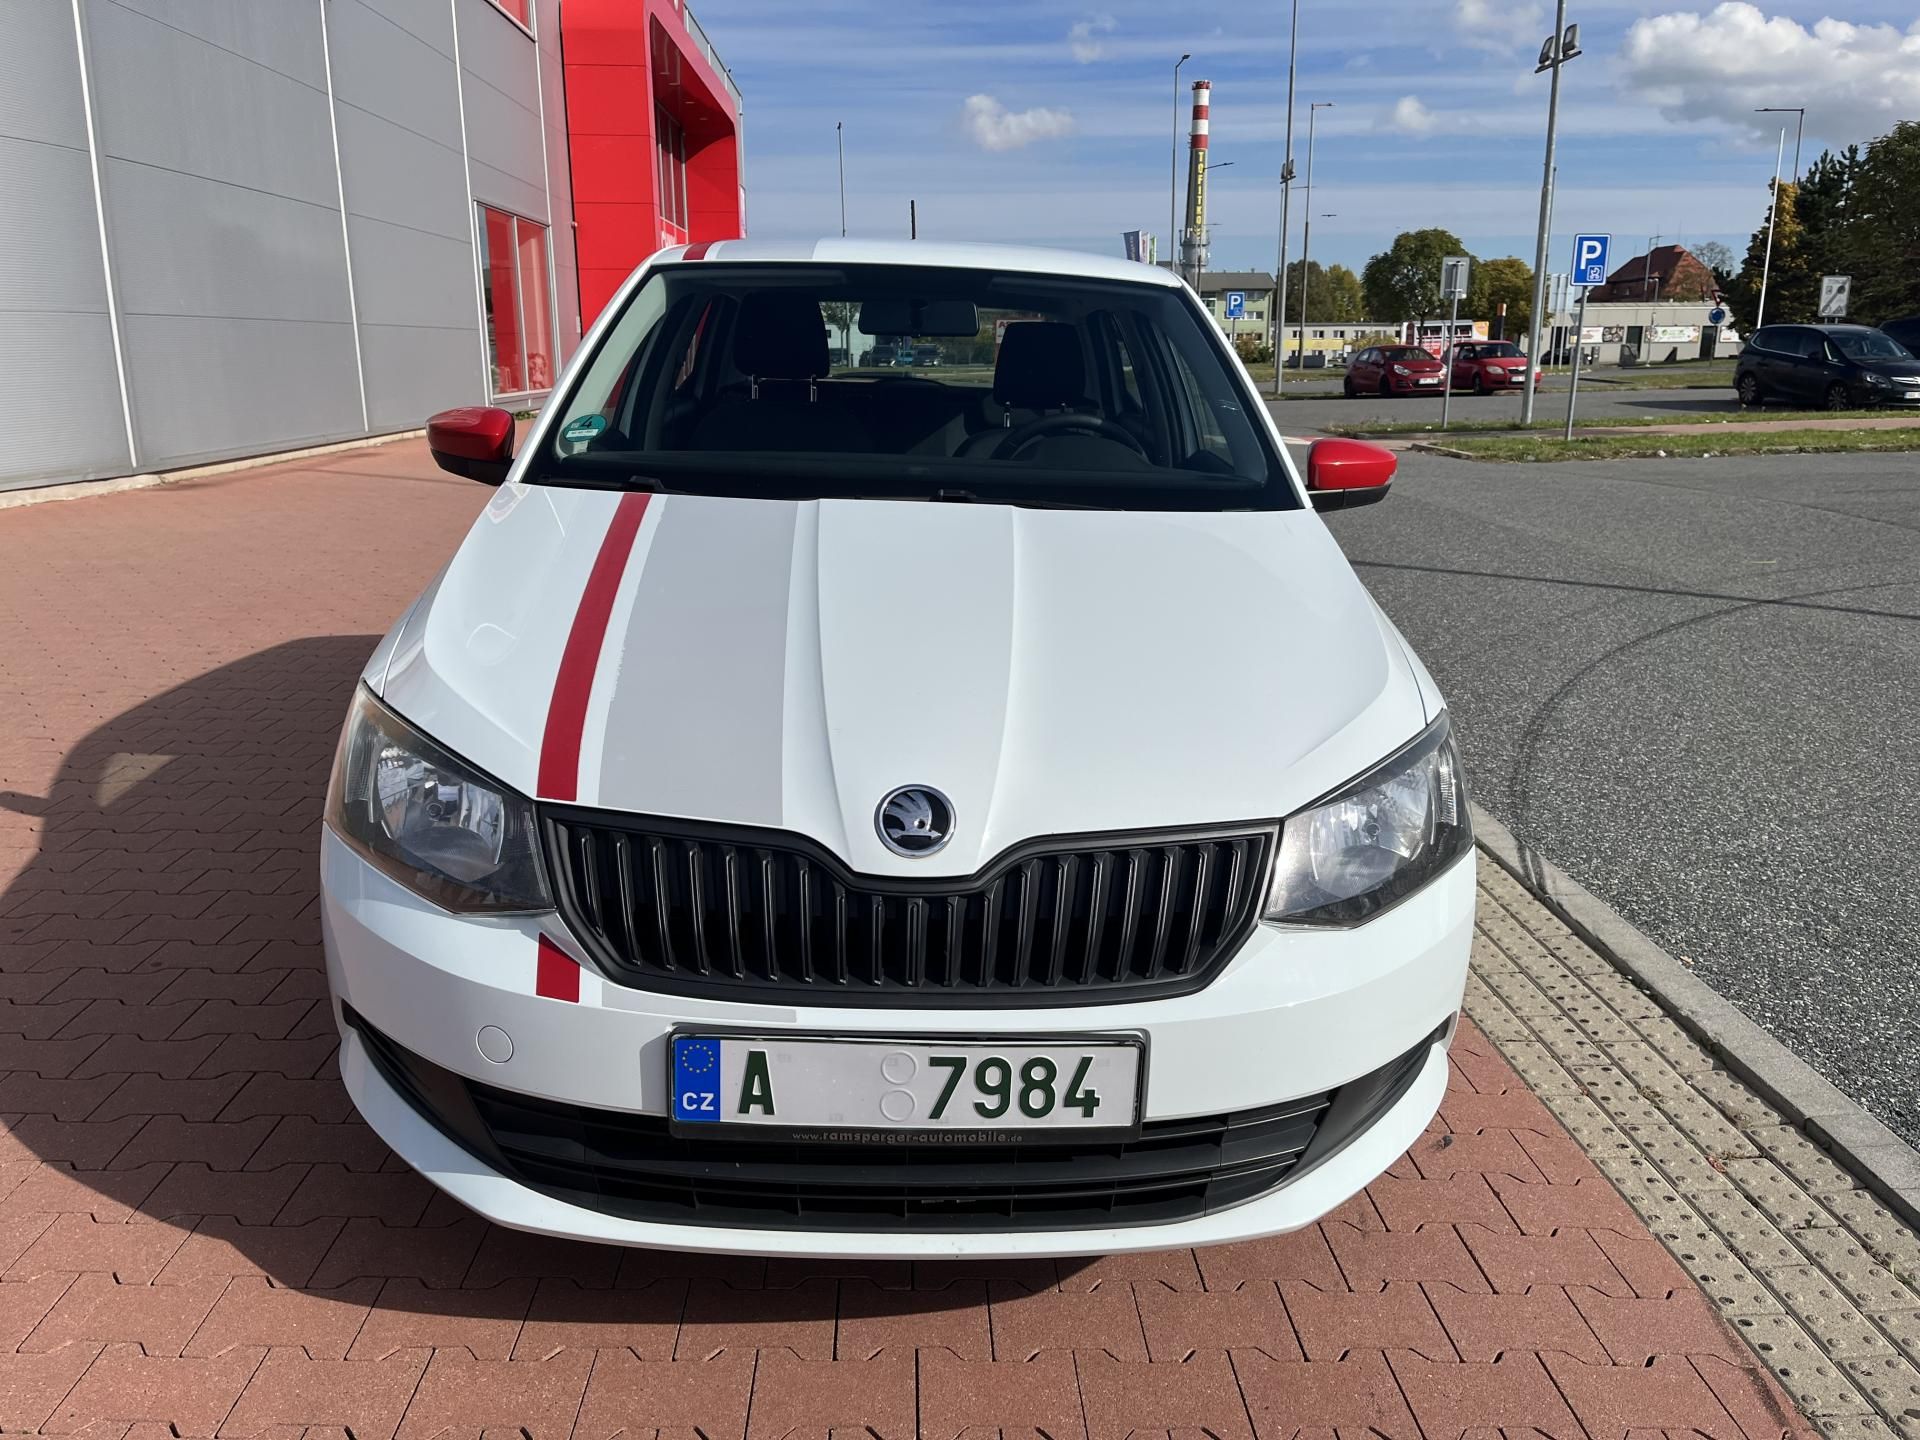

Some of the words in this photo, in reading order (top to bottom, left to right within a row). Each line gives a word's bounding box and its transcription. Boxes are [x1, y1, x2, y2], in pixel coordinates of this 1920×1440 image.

[1580, 241, 1602, 269] P
[1231, 296, 1241, 309] P
[581, 416, 592, 428] 4
[737, 1049, 776, 1116] A
[927, 1056, 1101, 1120] 7984
[682, 1092, 714, 1111] CZ
[792, 1130, 1023, 1144] www.ramsperger-automobile.de
